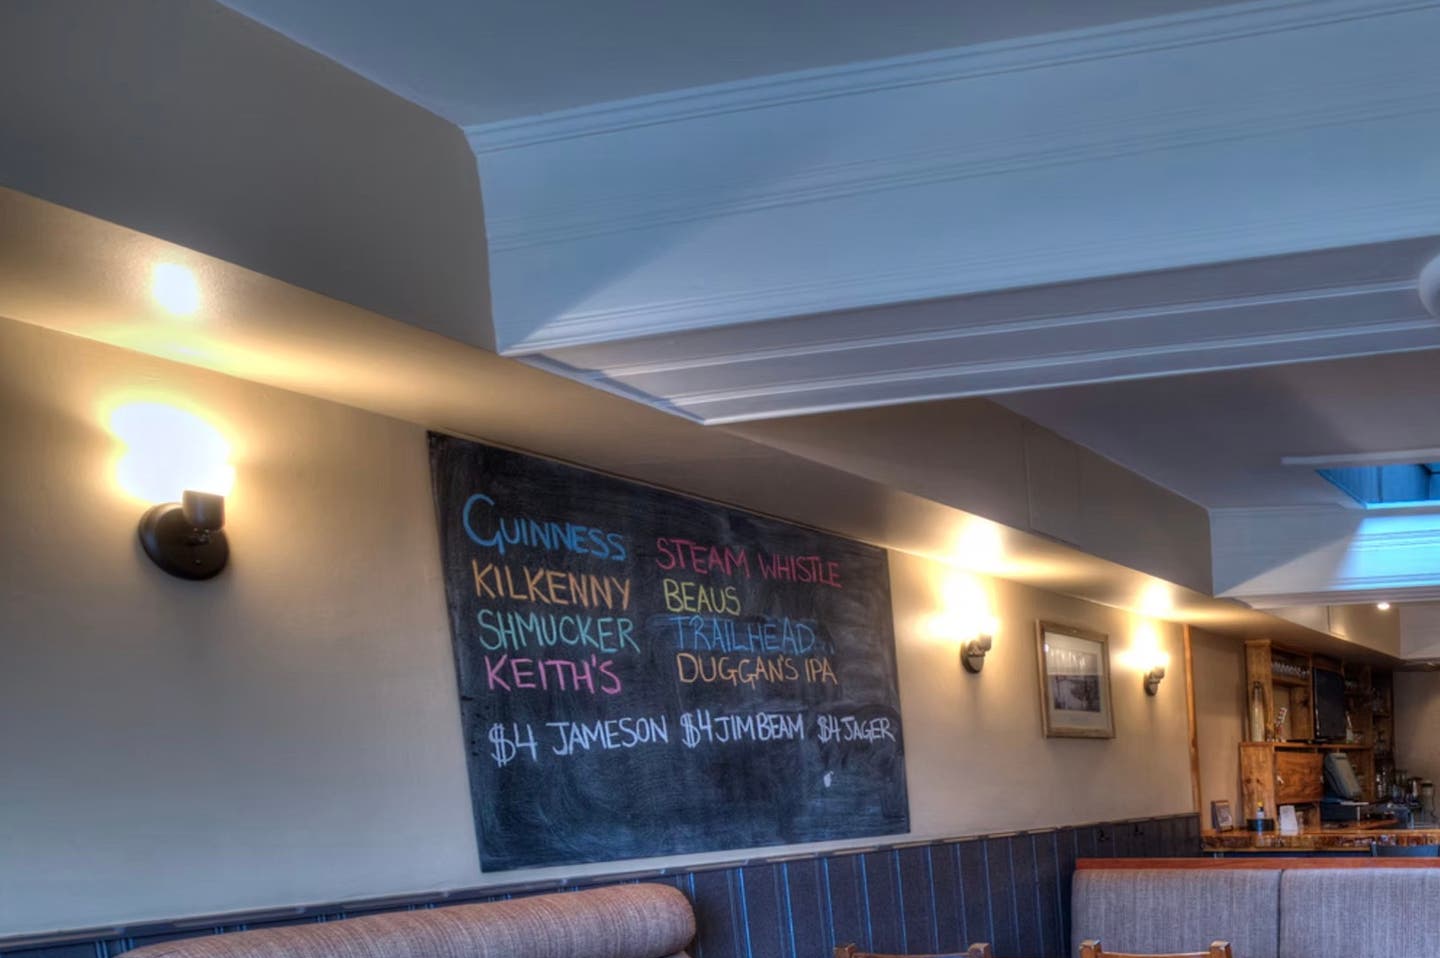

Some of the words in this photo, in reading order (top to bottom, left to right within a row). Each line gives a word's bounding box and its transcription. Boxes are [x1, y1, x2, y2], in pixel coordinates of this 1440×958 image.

[656, 537, 751, 578] STEAM
[758, 553, 842, 588] WHISTLE
[472, 559, 631, 611] KILKENNY
[663, 578, 741, 616] BEAUS
[477, 609, 641, 654] SHMUCKER
[668, 614, 817, 656] TRAILHEAD
[484, 653, 622, 694] KEITH'S
[676, 652, 799, 690] DUGGAN'S
[804, 656, 838, 685] IPA
[488, 722, 538, 768] $4
[546, 714, 668, 756] JAMESON
[680, 708, 712, 749] $4
[816, 709, 840, 743] $4
[840, 711, 896, 744] JAGER
